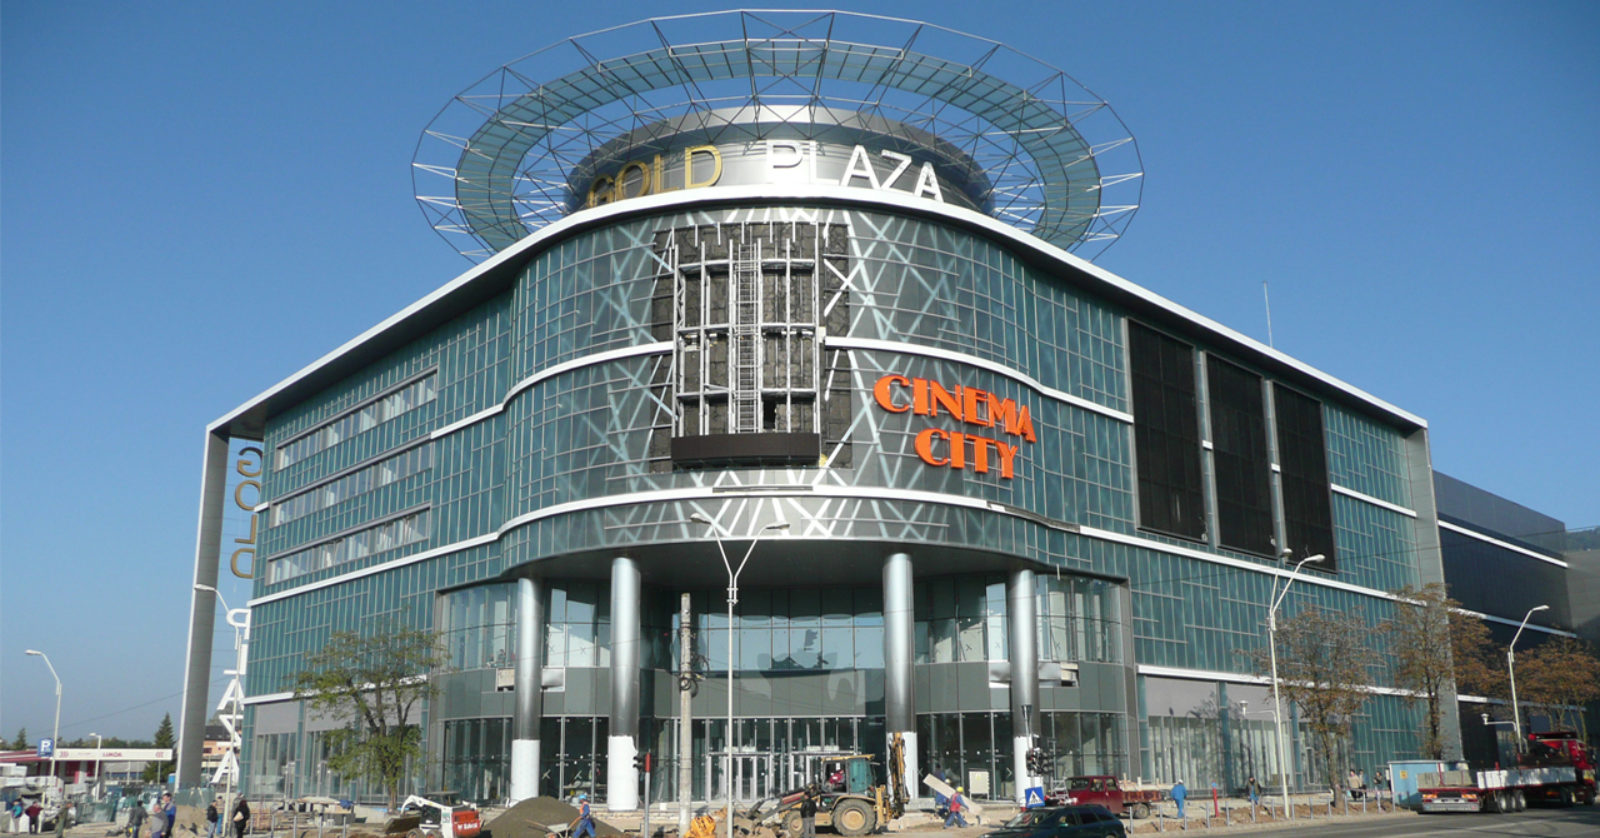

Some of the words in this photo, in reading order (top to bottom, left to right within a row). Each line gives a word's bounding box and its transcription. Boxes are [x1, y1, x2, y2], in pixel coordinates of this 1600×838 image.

[587, 145, 722, 207] GOLD
[767, 140, 944, 203] PLAZA
[873, 374, 1037, 443] CINEMA
[914, 428, 1018, 479] CITY
